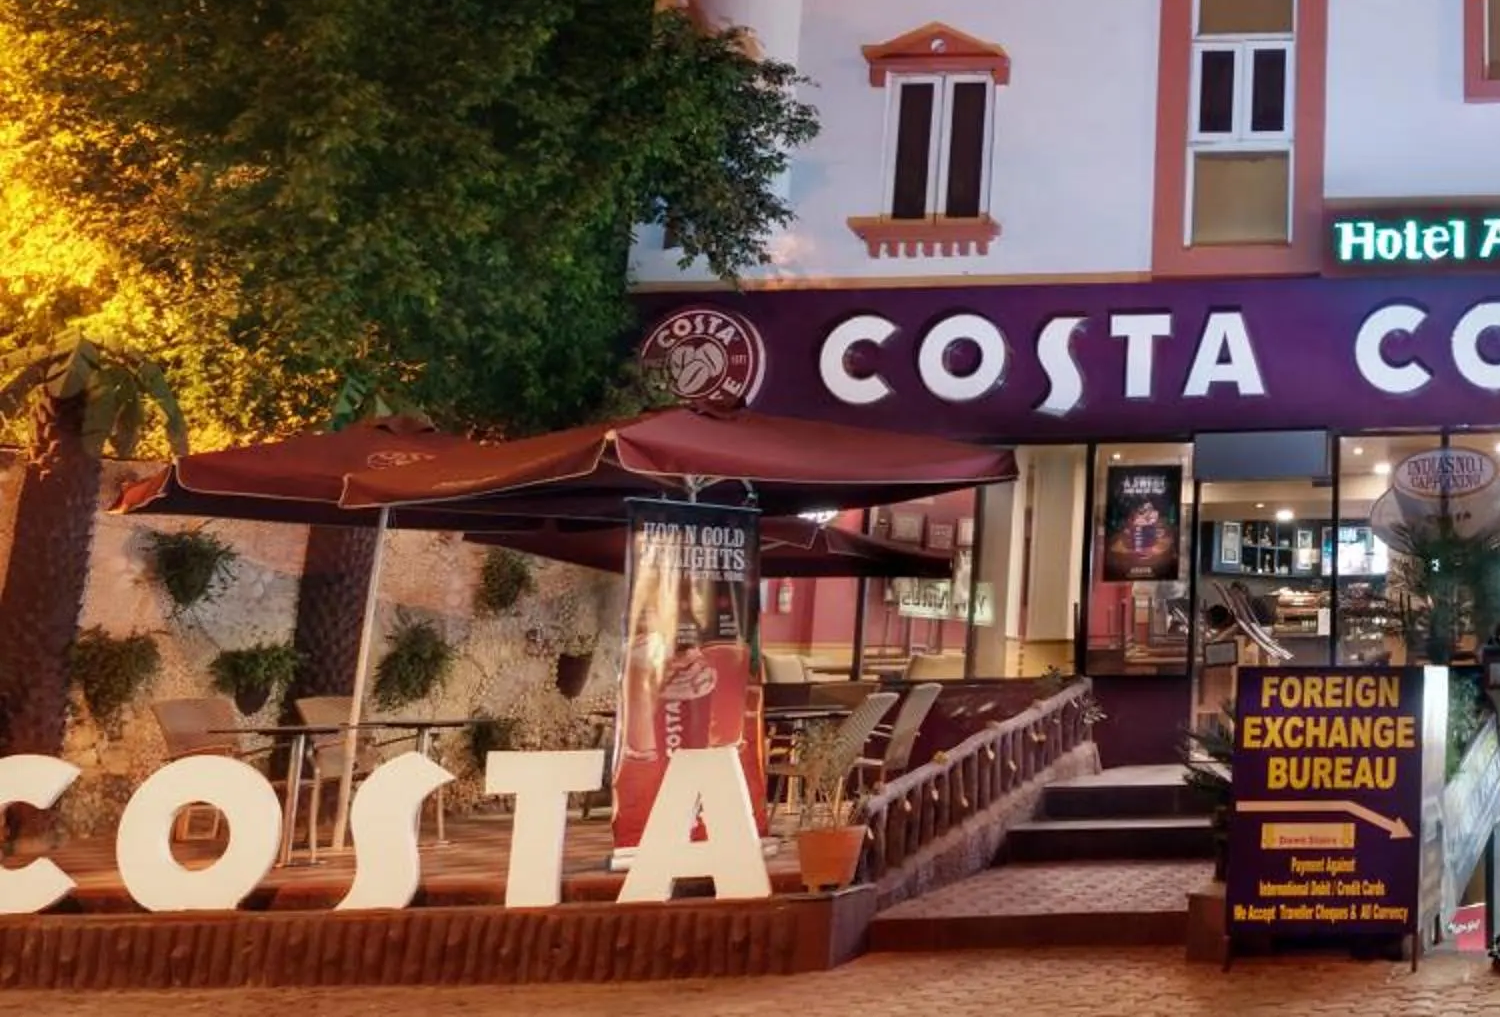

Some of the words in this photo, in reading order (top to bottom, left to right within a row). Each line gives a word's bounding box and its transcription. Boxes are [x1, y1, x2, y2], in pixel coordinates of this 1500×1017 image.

[1336, 221, 1466, 261] Hotel
[656, 314, 737, 349] COSTA
[818, 310, 1266, 417] COSTA
[701, 526, 746, 548] COLD
[641, 545, 746, 571] LIGHTS
[1261, 676, 1399, 709] FOREIGN
[1243, 716, 1416, 748] EXCHANGE
[1267, 756, 1398, 789] BUREAU
[0, 748, 772, 914] COSTA
